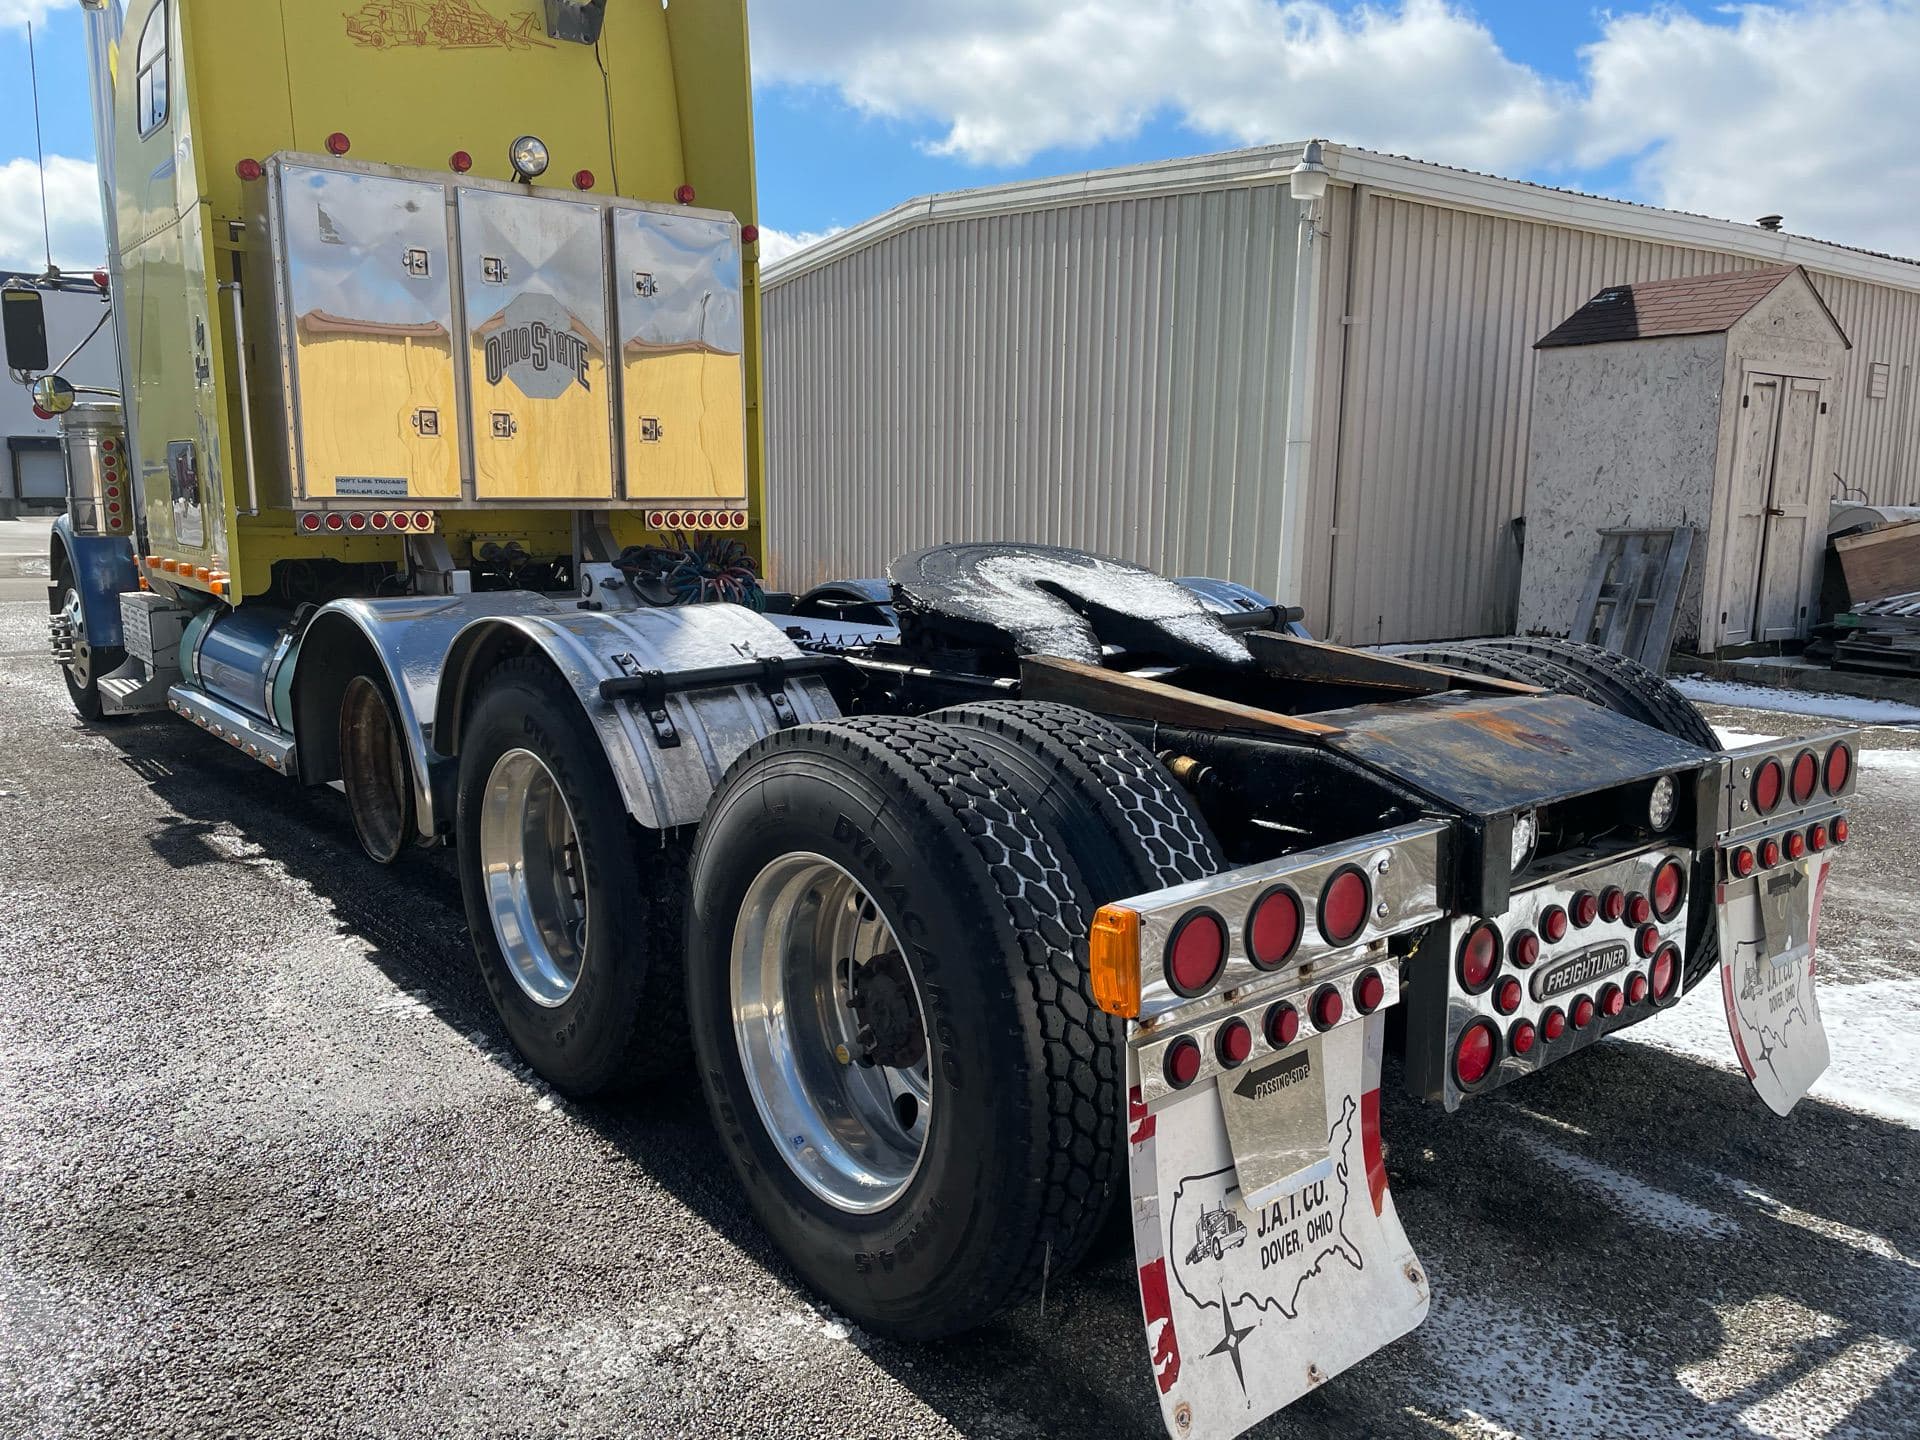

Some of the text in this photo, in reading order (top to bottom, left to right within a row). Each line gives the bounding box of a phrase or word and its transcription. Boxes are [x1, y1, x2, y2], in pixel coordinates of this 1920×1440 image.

[485, 321, 591, 393] OHIO STATE
[1546, 949, 1625, 992] FREIGHTLINER
[1256, 1064, 1310, 1100] PASSING SIDE
[1260, 1210, 1333, 1270] DOVER, OHIO
